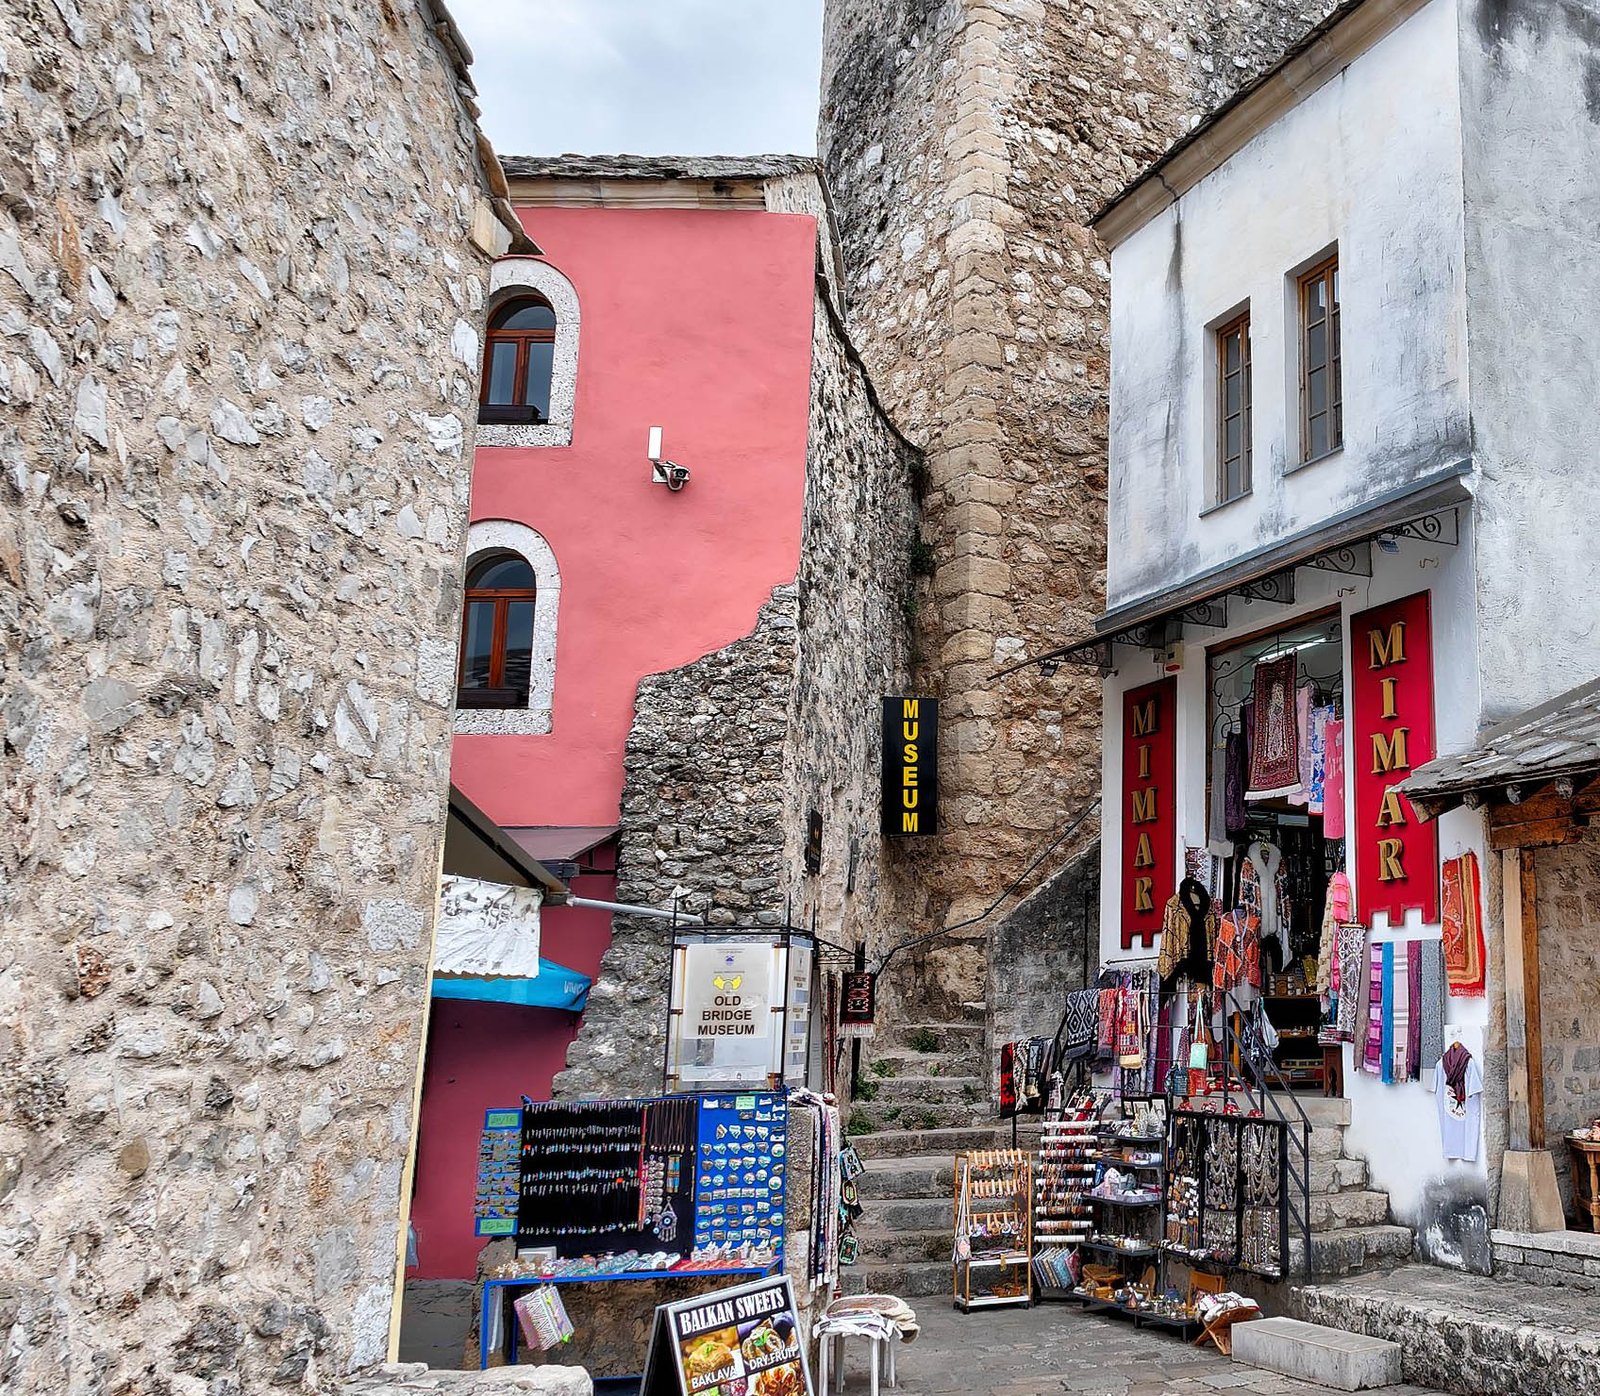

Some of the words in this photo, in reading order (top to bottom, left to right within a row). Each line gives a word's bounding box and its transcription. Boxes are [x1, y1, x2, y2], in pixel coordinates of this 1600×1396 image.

[1367, 620, 1411, 882] MIMAR
[902, 699, 919, 833] MUSEUM
[1131, 699, 1159, 913] MIMAR
[714, 995, 741, 1006] OLD
[702, 1009, 752, 1021] BRIDGE
[697, 1024, 755, 1036] MUSEUM
[679, 1300, 735, 1335] BALKAN
[735, 1286, 785, 1319] SWEETS
[749, 1354, 770, 1371] DRY
[770, 1347, 798, 1365] FRUIT
[691, 1365, 737, 1389] BAKLAVA
